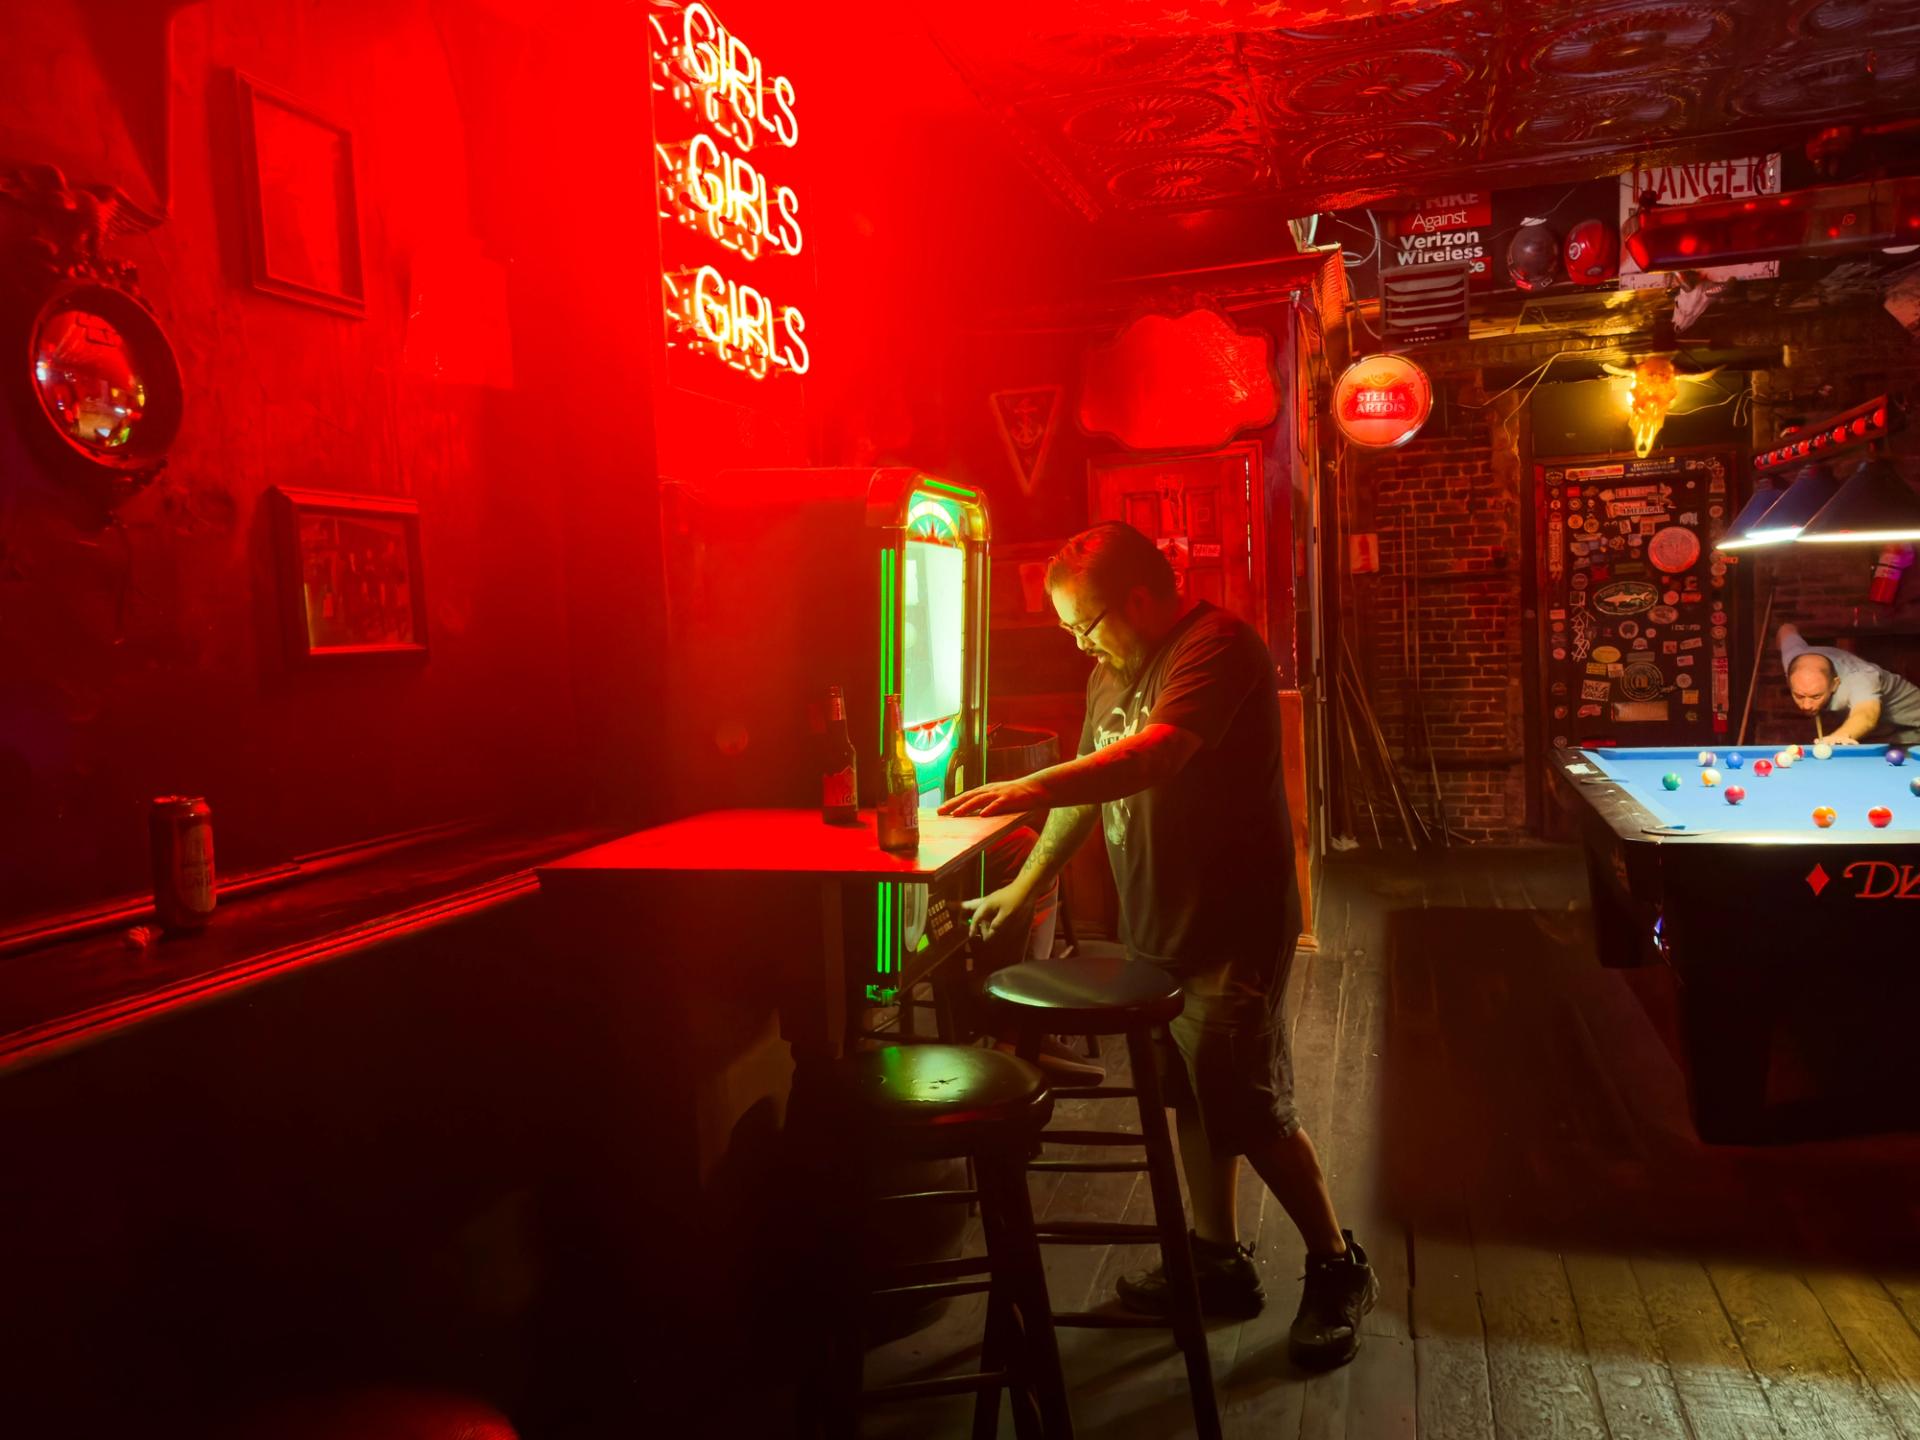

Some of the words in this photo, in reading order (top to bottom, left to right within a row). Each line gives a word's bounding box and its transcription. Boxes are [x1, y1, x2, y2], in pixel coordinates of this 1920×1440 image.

[684, 3, 799, 147] GIRLS
[690, 134, 802, 255] GIRLS
[1411, 208, 1468, 232] Against
[1400, 231, 1479, 250] Verizon
[1397, 246, 1483, 266] Wireless
[695, 266, 809, 374] GIRLS
[1356, 401, 1406, 413] ARTOIS
[1357, 391, 1405, 402] STELLA
